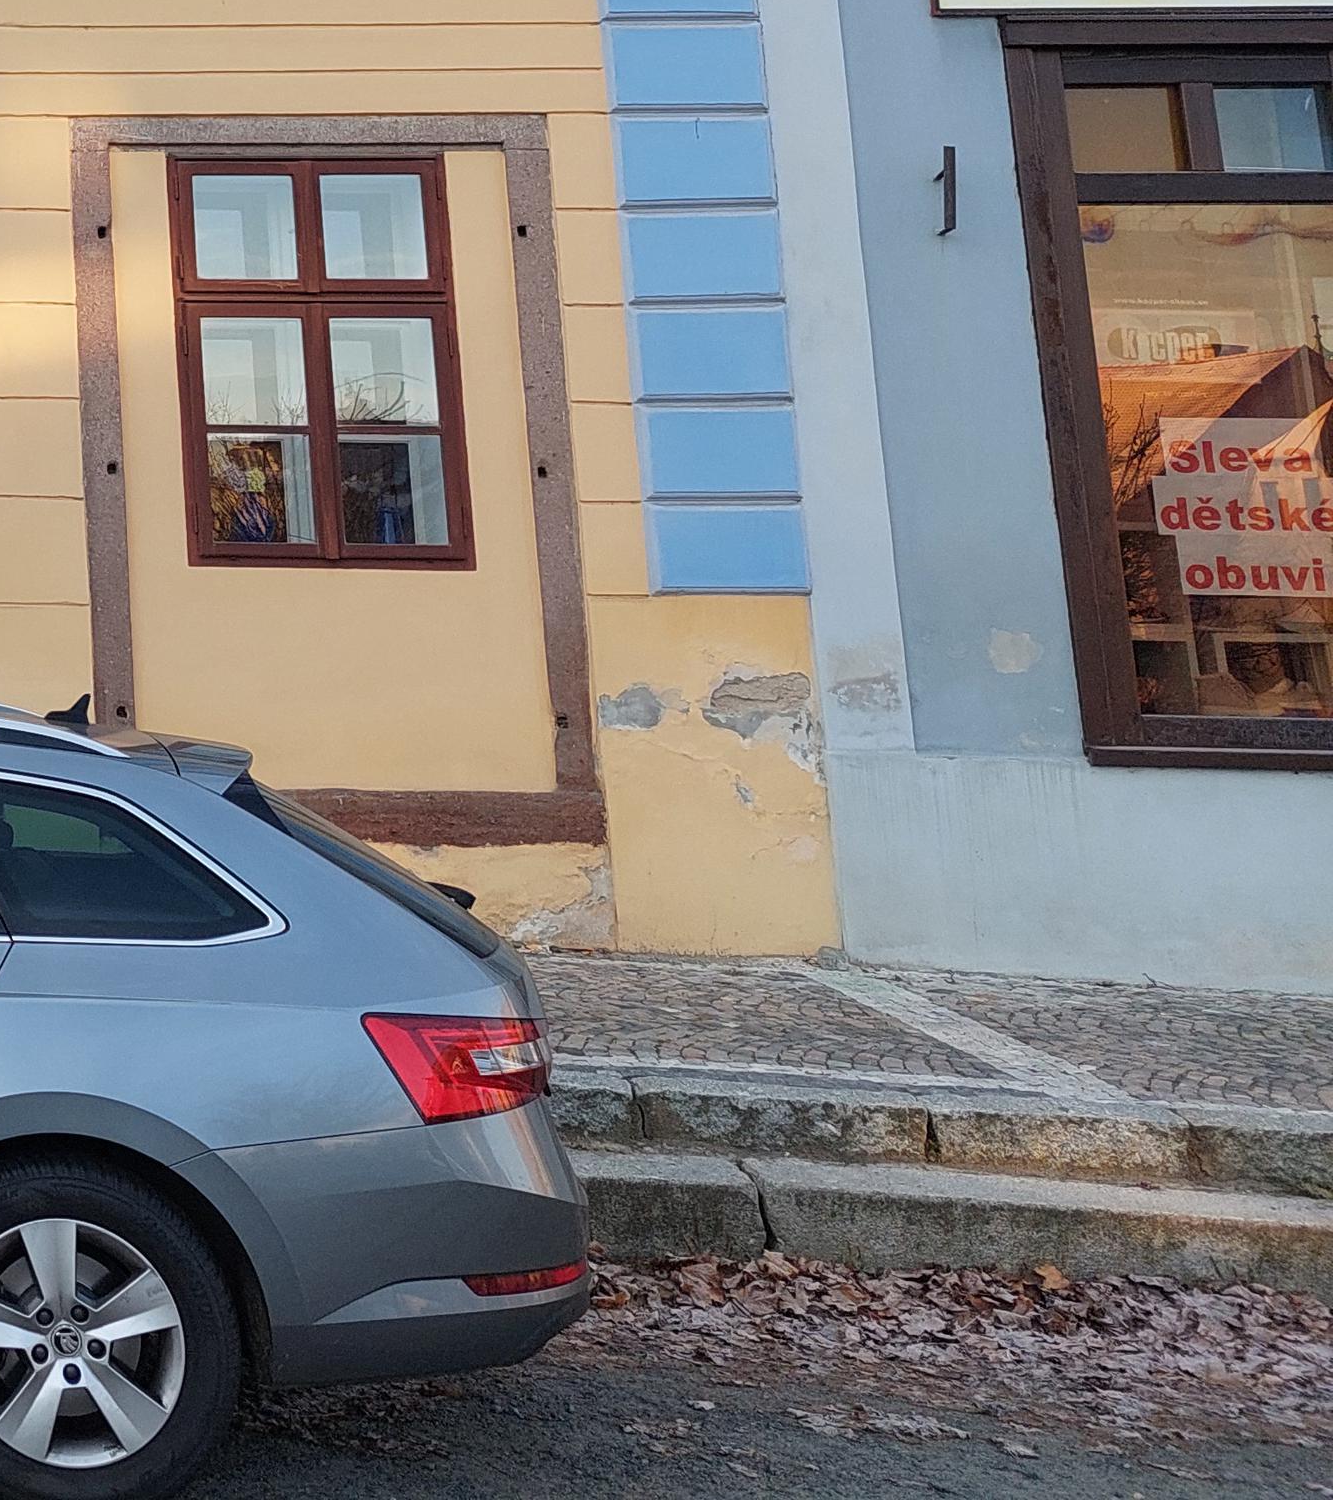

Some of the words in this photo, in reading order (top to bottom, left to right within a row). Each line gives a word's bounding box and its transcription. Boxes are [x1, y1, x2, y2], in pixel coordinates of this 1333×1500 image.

[1169, 441, 1312, 474] Sleva
[1160, 497, 1333, 532] dětské
[1185, 556, 1326, 591] obuvi
